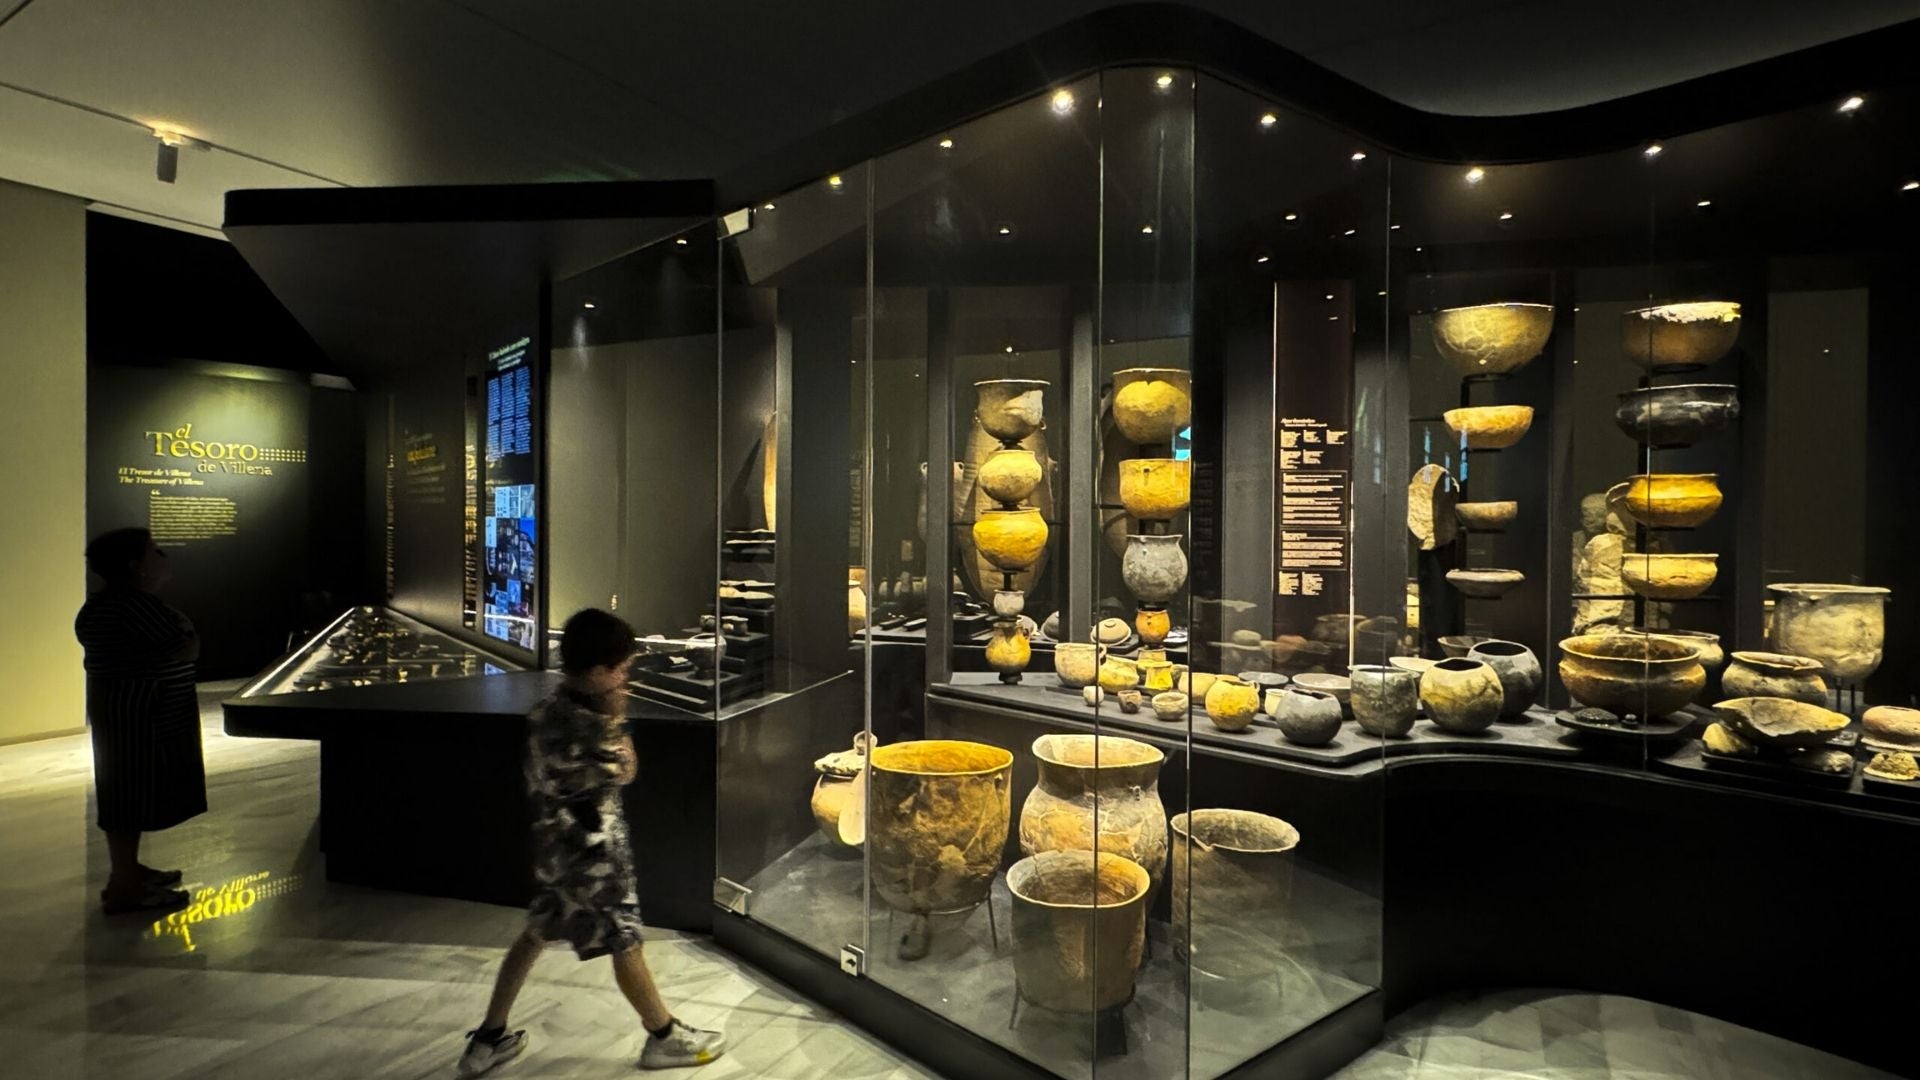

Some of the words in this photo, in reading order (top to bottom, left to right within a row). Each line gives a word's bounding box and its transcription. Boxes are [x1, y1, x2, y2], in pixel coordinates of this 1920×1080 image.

[175, 424, 192, 439] el
[144, 431, 258, 461] Tesoro
[197, 460, 217, 473] de
[219, 461, 273, 476] Villena
[119, 476, 134, 484] The
